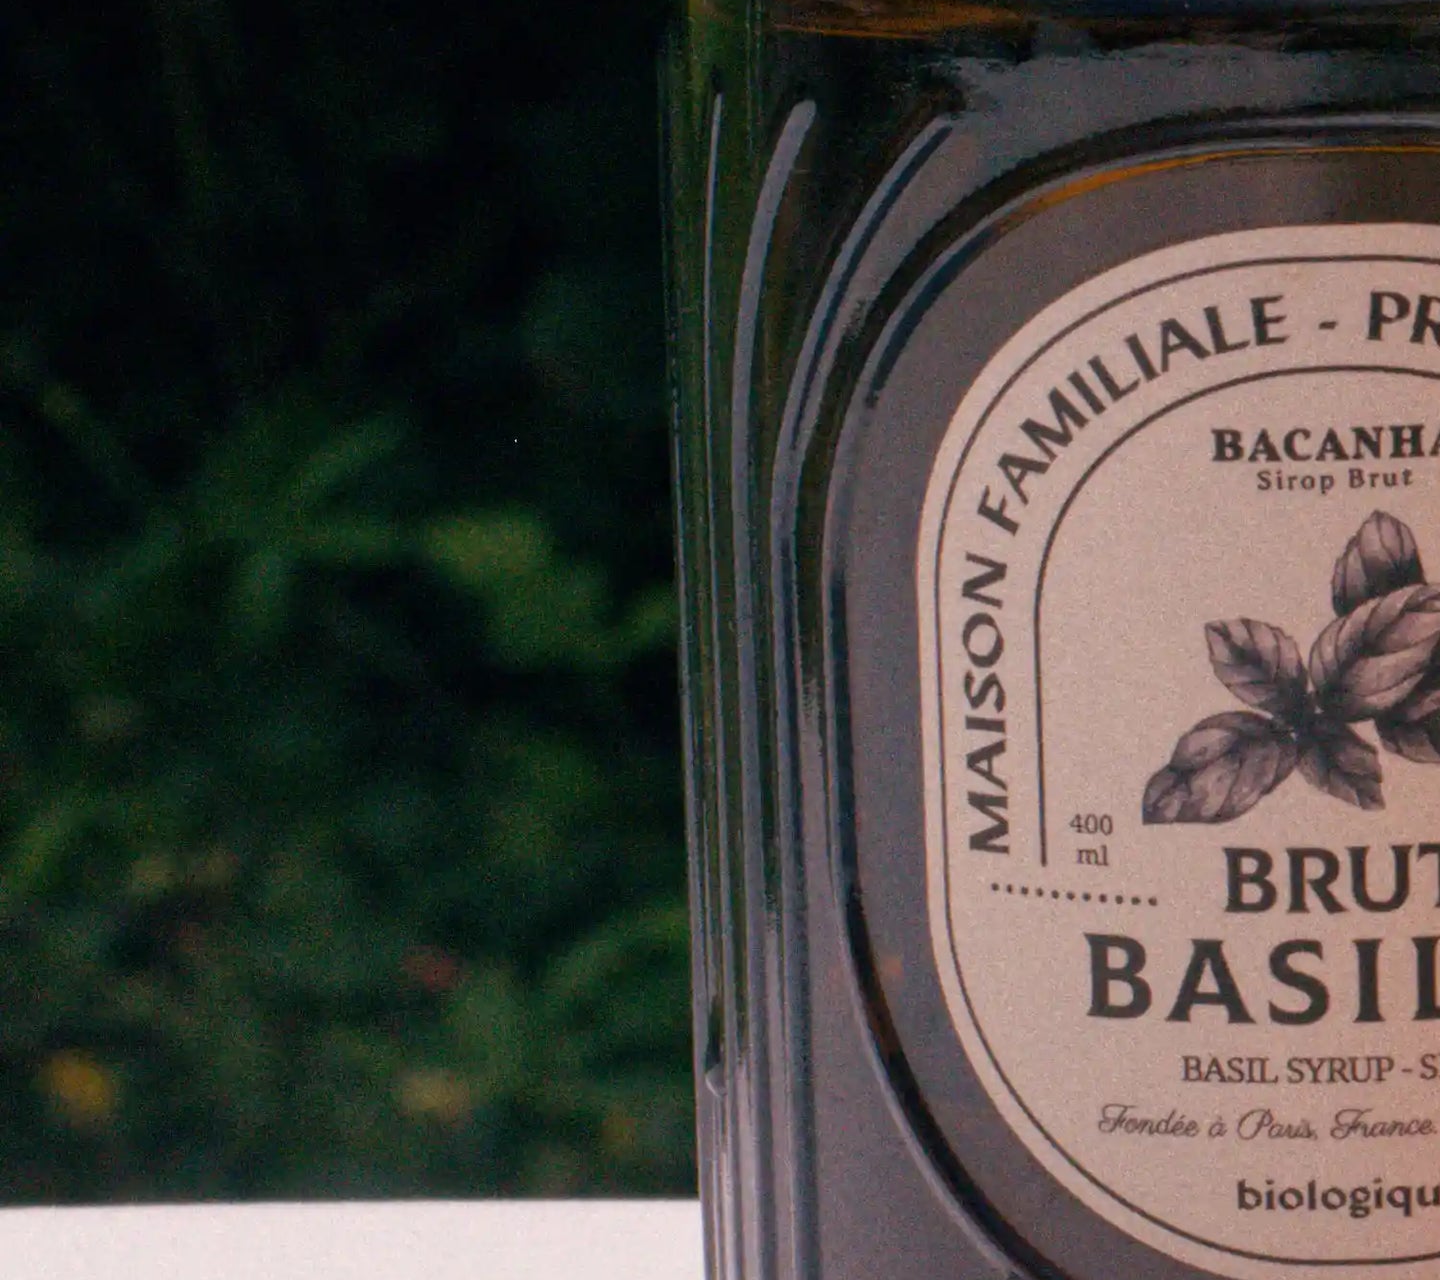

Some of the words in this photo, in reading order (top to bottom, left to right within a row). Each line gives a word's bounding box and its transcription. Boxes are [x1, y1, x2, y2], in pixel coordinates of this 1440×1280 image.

[976, 294, 1288, 538] FAMILIALE
[1256, 469, 1336, 495] Sirop
[1347, 467, 1414, 489] Brut
[959, 550, 1012, 856] MAISON
[1068, 813, 1114, 837] 400
[1076, 843, 1109, 868] ml
[1181, 1056, 1279, 1084] BASIL
[1286, 1056, 1395, 1083] SYRUP
[1099, 1103, 1200, 1138] Fondée
[1208, 1116, 1225, 1138] à
